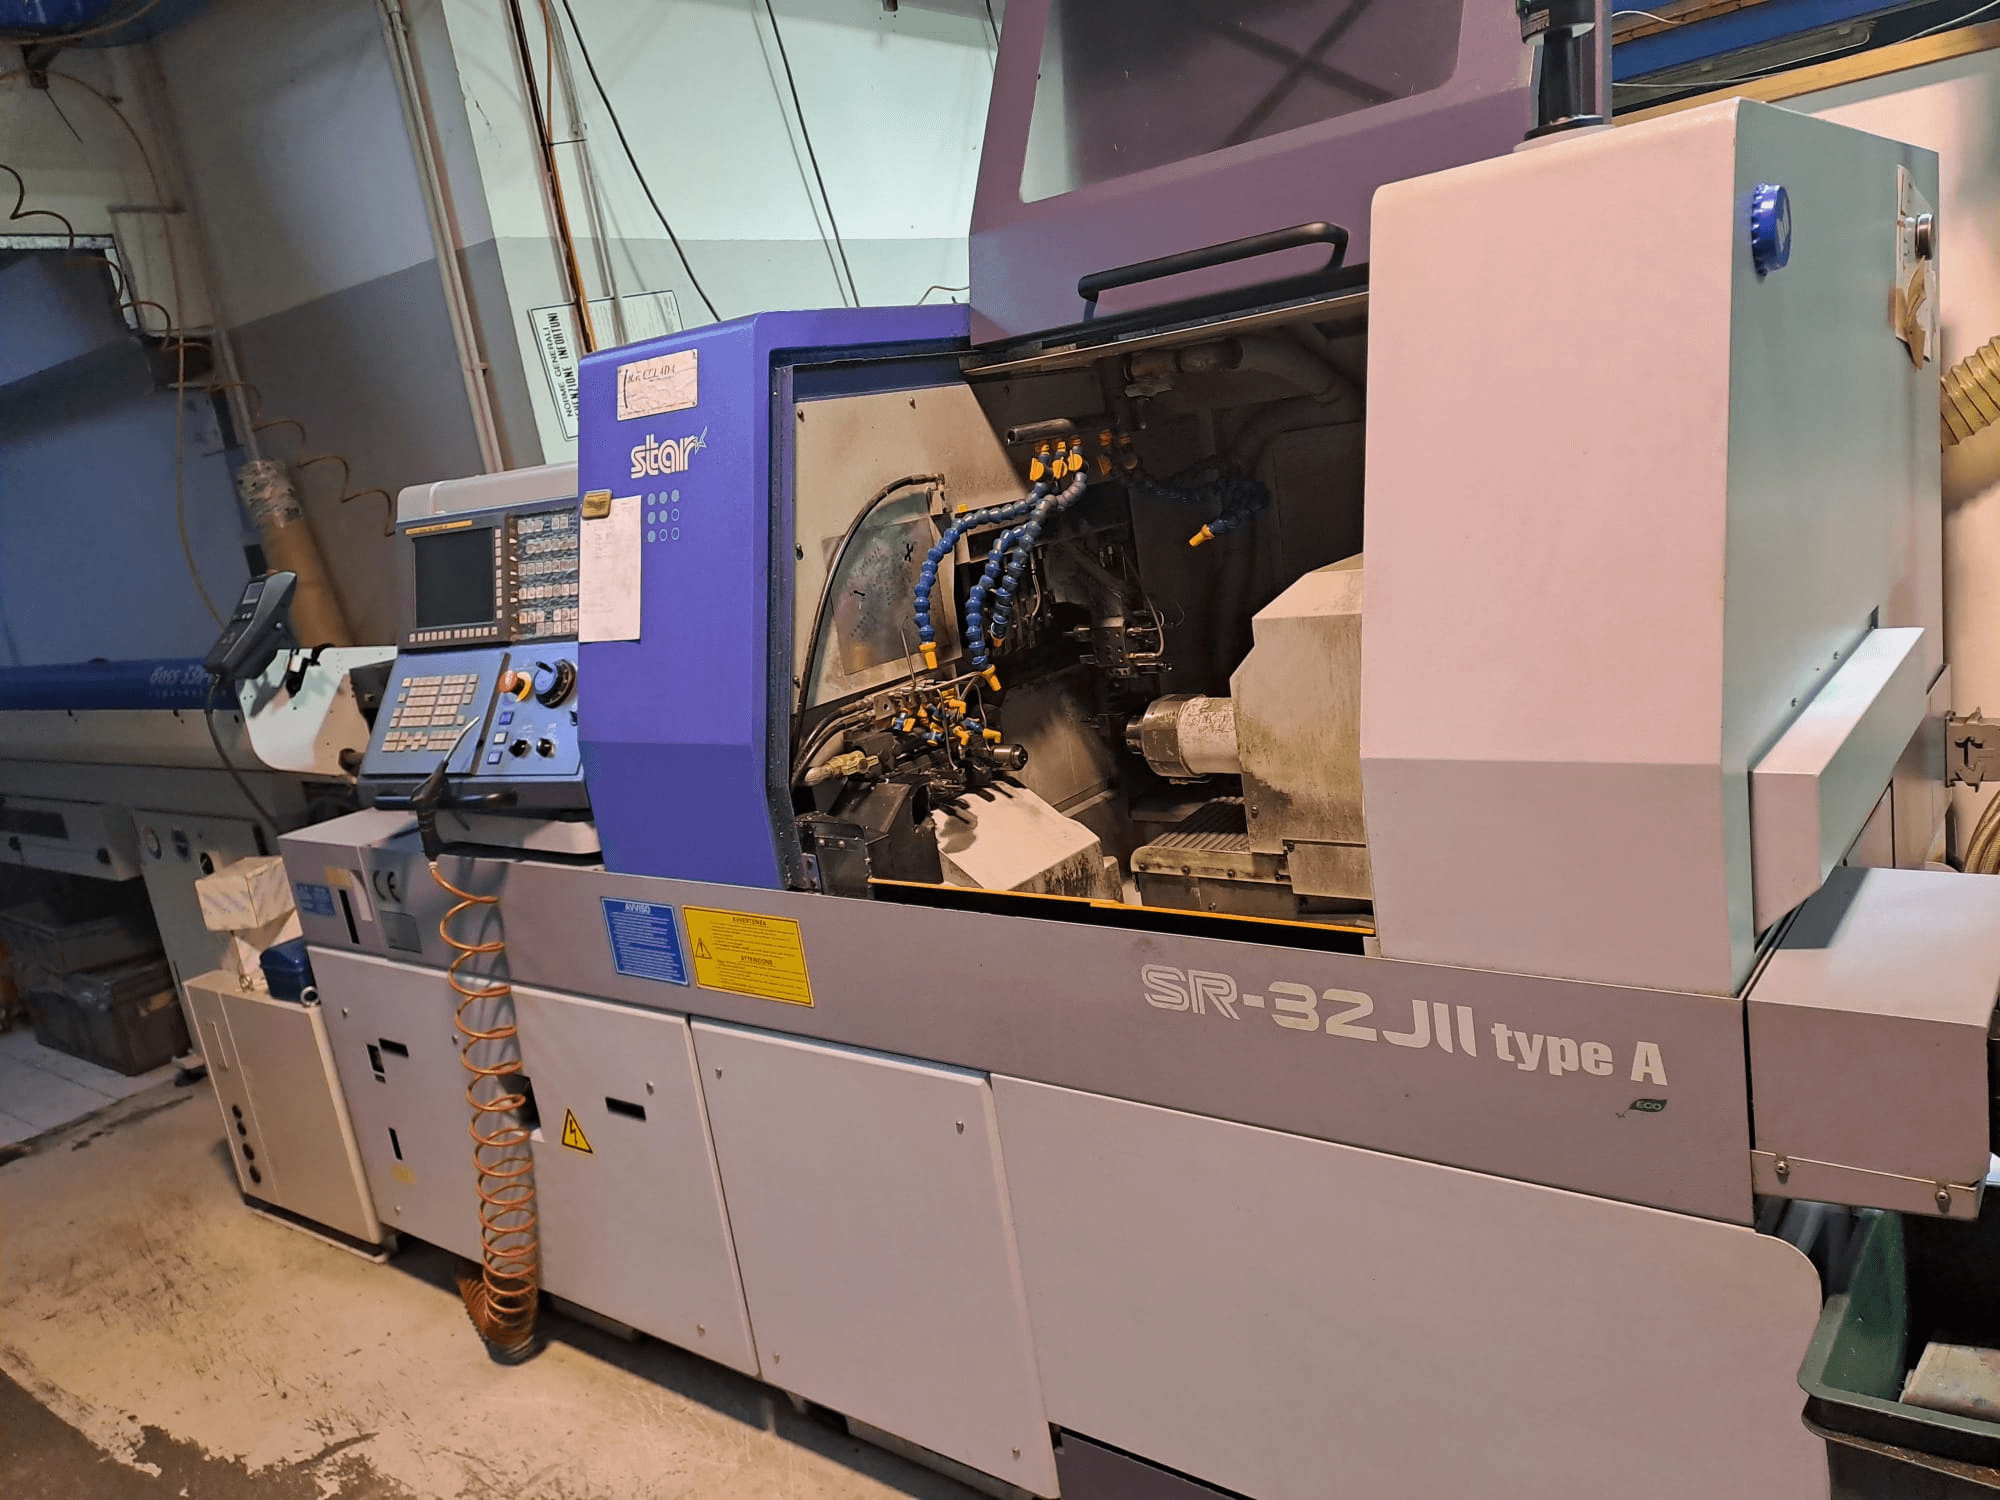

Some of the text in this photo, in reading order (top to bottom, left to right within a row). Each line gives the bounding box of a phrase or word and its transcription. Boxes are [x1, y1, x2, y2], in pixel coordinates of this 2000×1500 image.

[546, 312, 569, 360] INFORTUNI
[543, 326, 573, 417] NORME GENERALI
[630, 433, 698, 479] star
[1490, 1022, 1614, 1077] type
[1630, 1040, 1669, 1087] A
[1636, 1100, 1662, 1111] ECO
